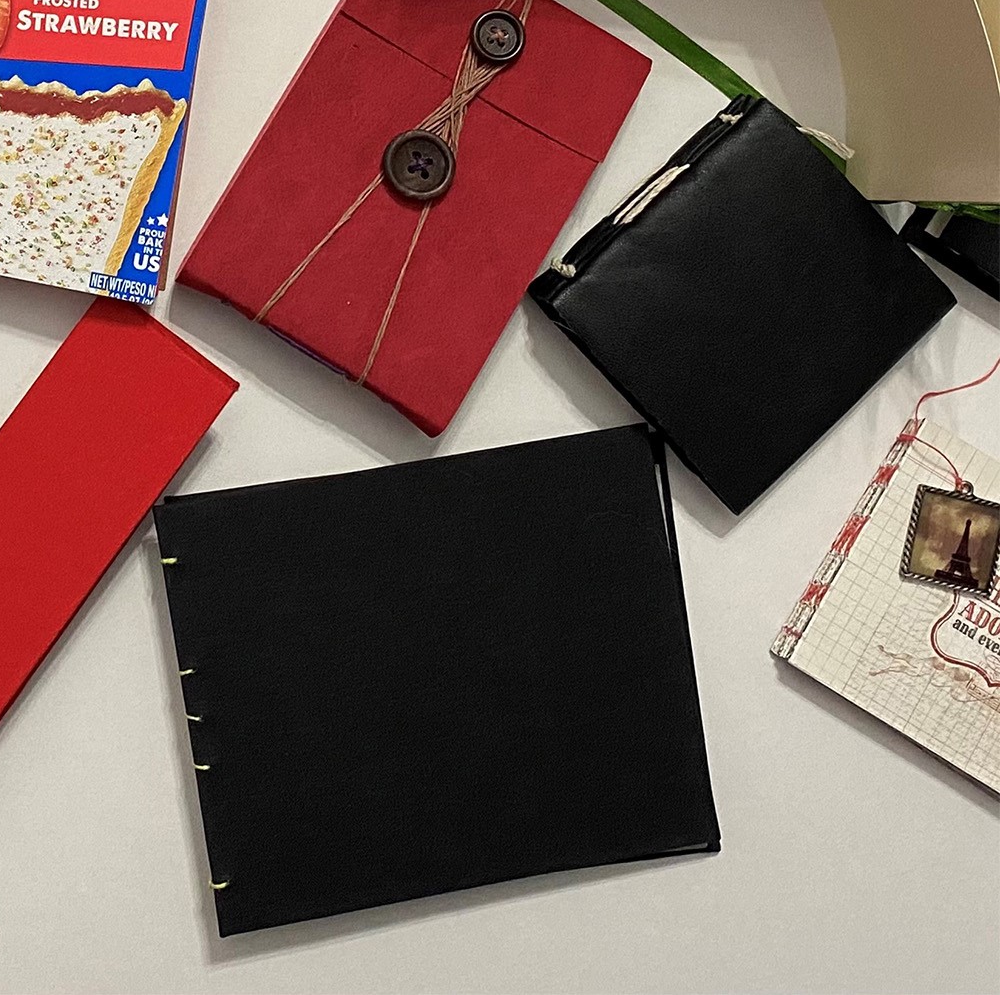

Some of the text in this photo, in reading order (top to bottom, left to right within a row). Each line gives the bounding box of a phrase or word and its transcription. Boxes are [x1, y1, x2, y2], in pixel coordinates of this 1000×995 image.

[16, 9, 179, 41] STRAWBERRY
[143, 246, 154, 255] IN
[90, 273, 109, 290] NET
[108, 277, 147, 296] WT/PESO
[952, 618, 979, 640] and
